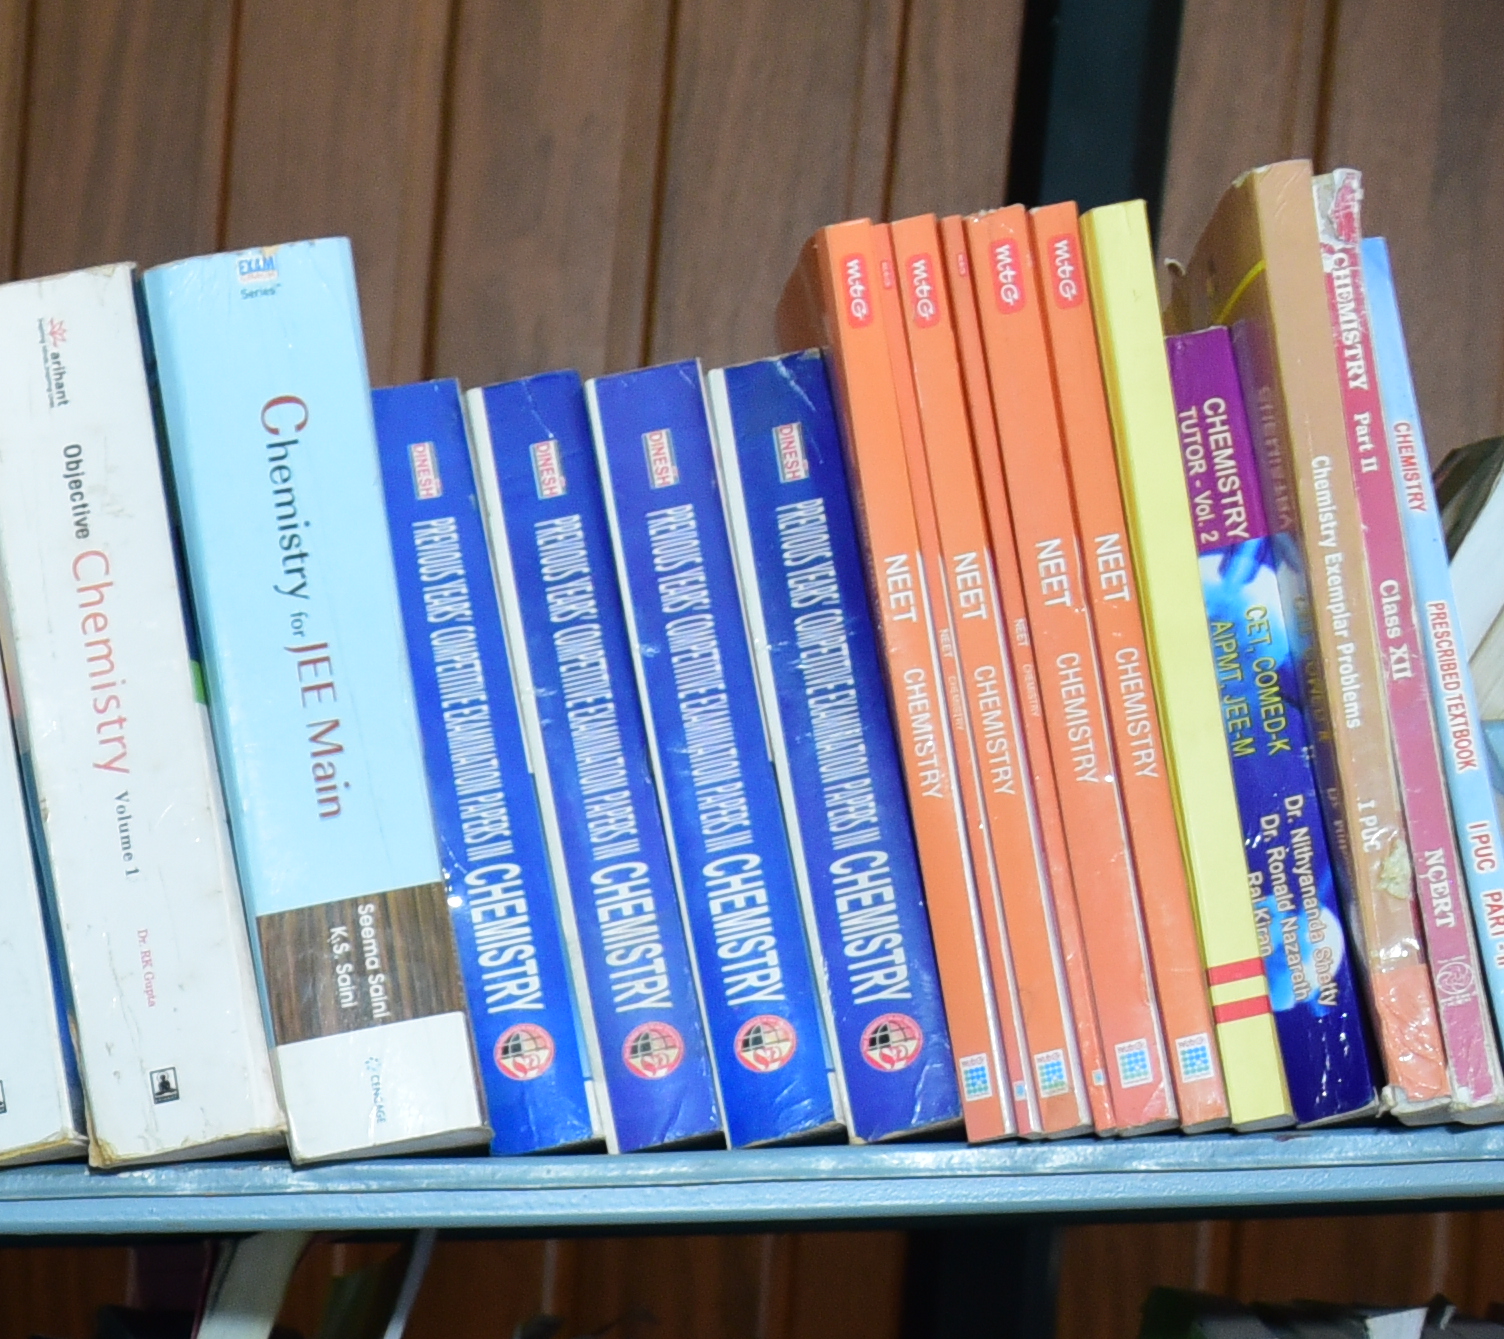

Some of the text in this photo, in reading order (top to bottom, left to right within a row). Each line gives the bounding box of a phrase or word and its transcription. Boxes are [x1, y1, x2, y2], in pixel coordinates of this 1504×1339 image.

[63, 444, 130, 774] Objective Chemistry
[261, 394, 351, 820] Chemistry for Main
[953, 552, 1015, 795] NEET CHEMISTRY
[1094, 533, 1159, 778] NEET CHEMISTRY
[1312, 455, 1361, 730] Chemistry Exemplar Problems
[1331, 253, 1455, 928] CHEMISTRY Part II Class XII NCERT
[1393, 422, 1496, 874] CHEMISTRY PRESCRIBED TEXTBOOK PUC
[464, 862, 544, 1012] CHEMISTRY
[703, 854, 785, 1006] CHEMISTRY
[830, 851, 912, 1005] CHEMISTRY
